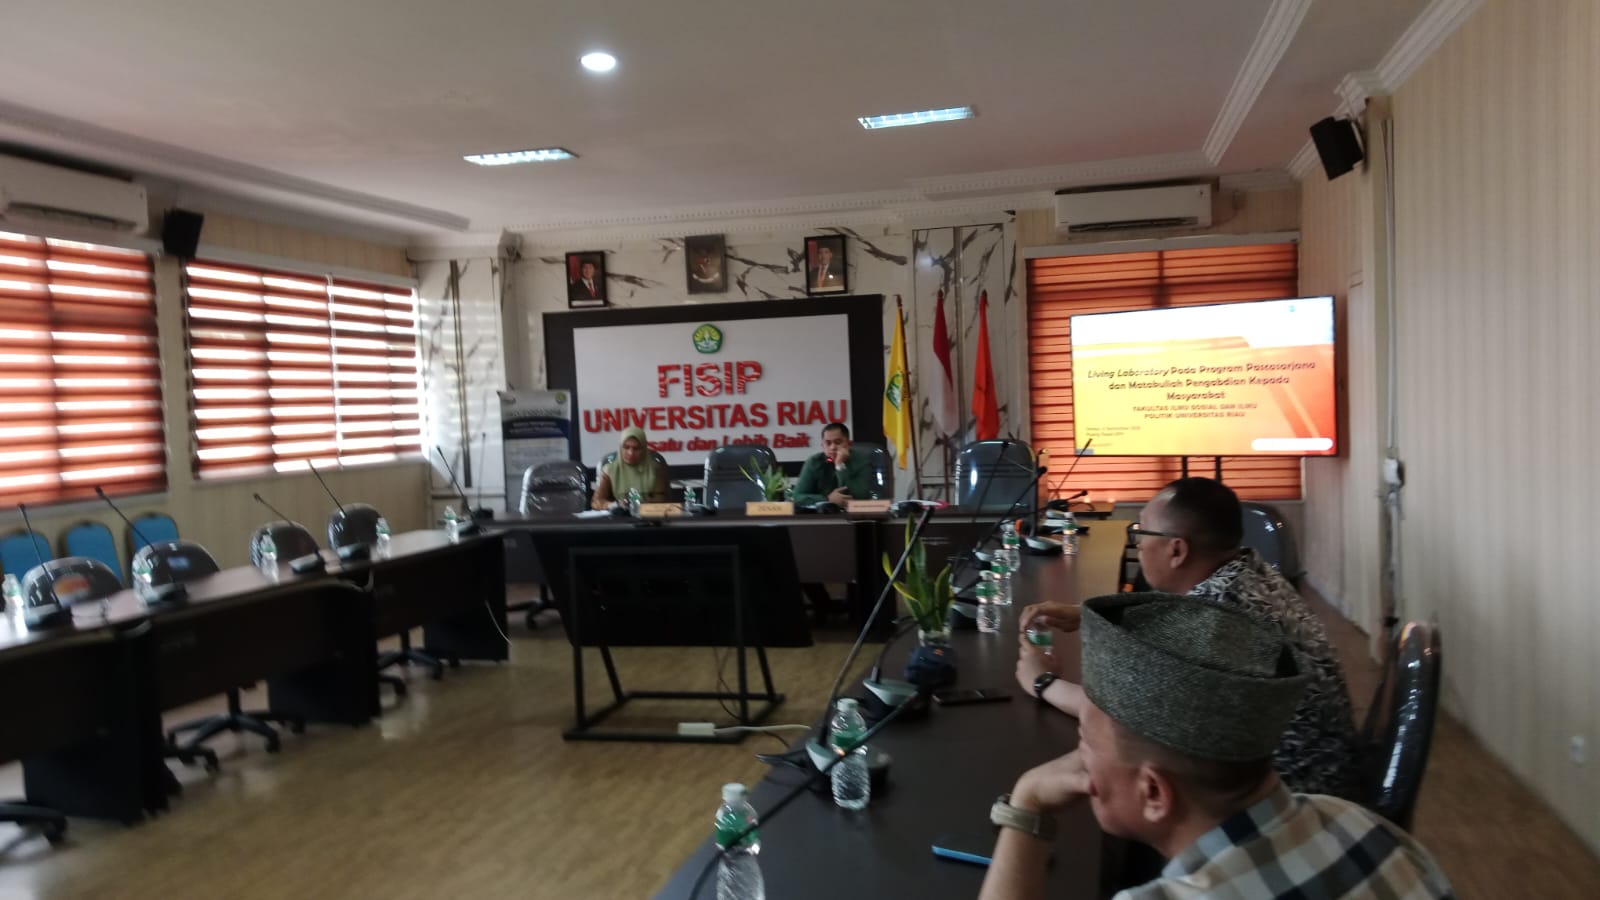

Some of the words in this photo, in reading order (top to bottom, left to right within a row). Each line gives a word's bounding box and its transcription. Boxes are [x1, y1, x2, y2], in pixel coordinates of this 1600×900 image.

[657, 360, 763, 398] FISIP
[1087, 369, 1116, 379] Living
[1117, 367, 1169, 377] Laboratory
[1170, 366, 1197, 374] Pada
[1199, 365, 1243, 374] Program
[1245, 362, 1316, 372] Pascasarjana
[1108, 382, 1127, 390] dan
[1185, 378, 1247, 388] Pengabdian
[1248, 376, 1290, 386] Kepada
[583, 403, 769, 433] UNIVERSITAS
[777, 399, 848, 429] RIAU
[647, 438, 684, 452] satu
[687, 436, 717, 451] dan
[773, 432, 811, 448] Baik
